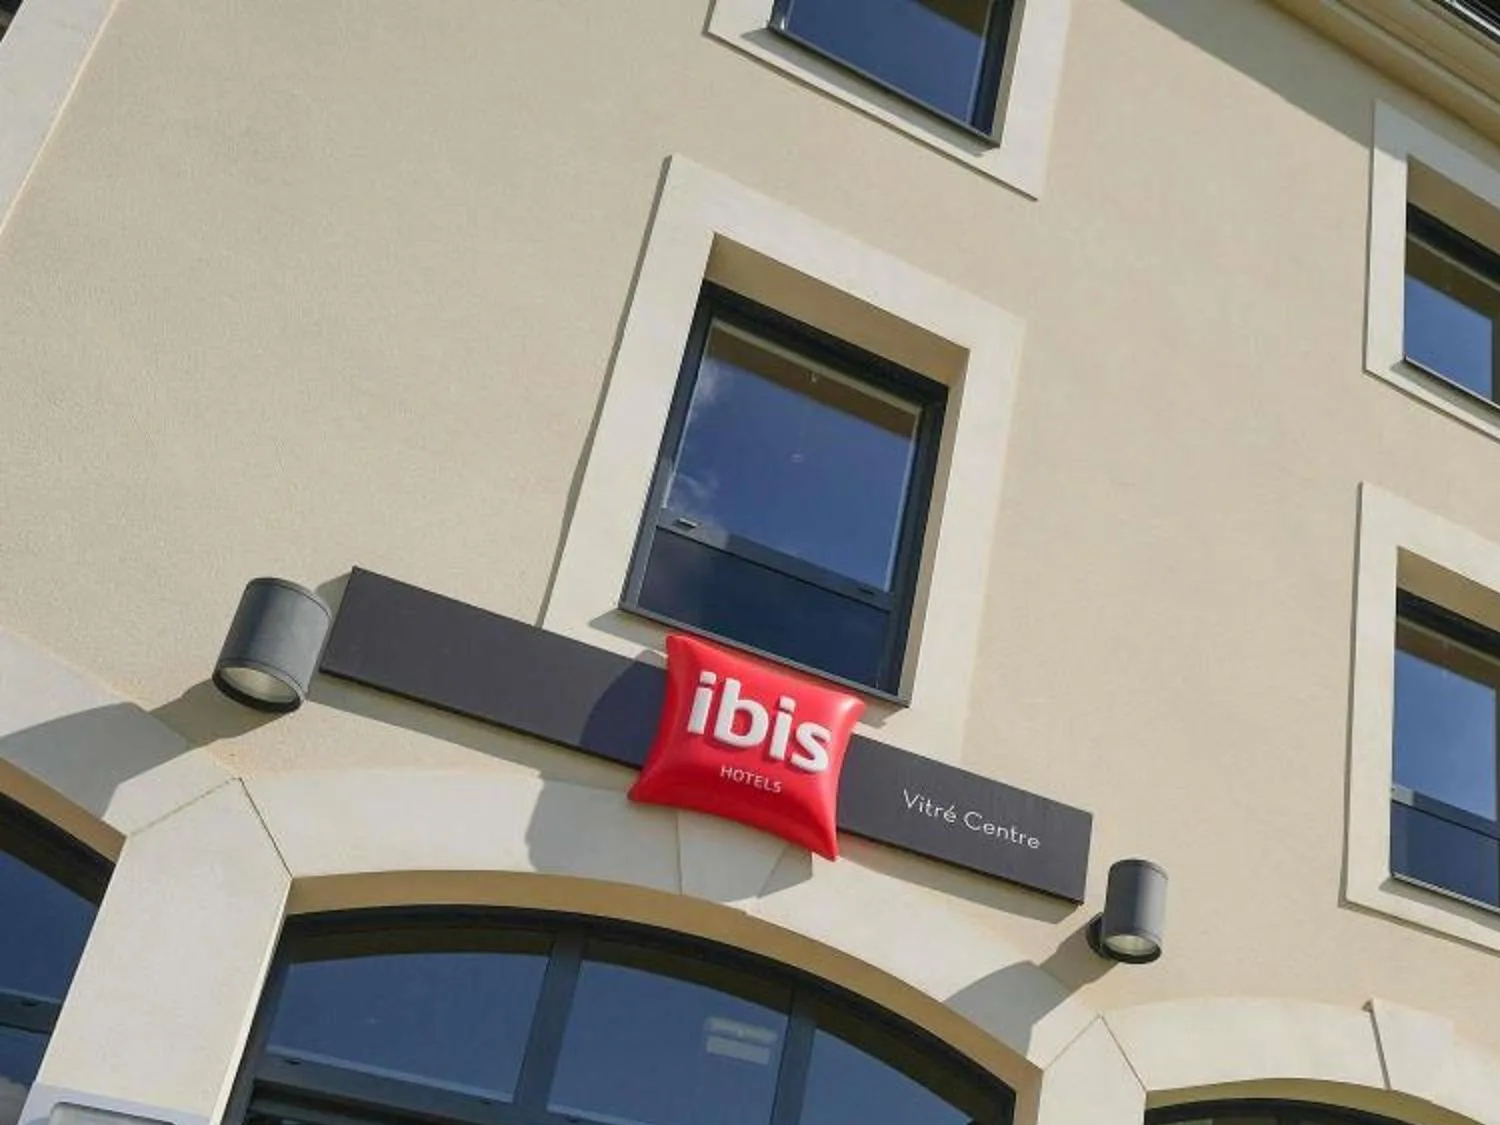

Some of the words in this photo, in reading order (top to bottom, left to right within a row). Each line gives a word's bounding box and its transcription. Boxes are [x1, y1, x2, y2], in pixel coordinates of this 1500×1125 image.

[687, 671, 833, 773] ibis
[720, 765, 782, 793] HOTELS
[903, 788, 957, 823] Vitré
[963, 811, 1041, 849] Centre
